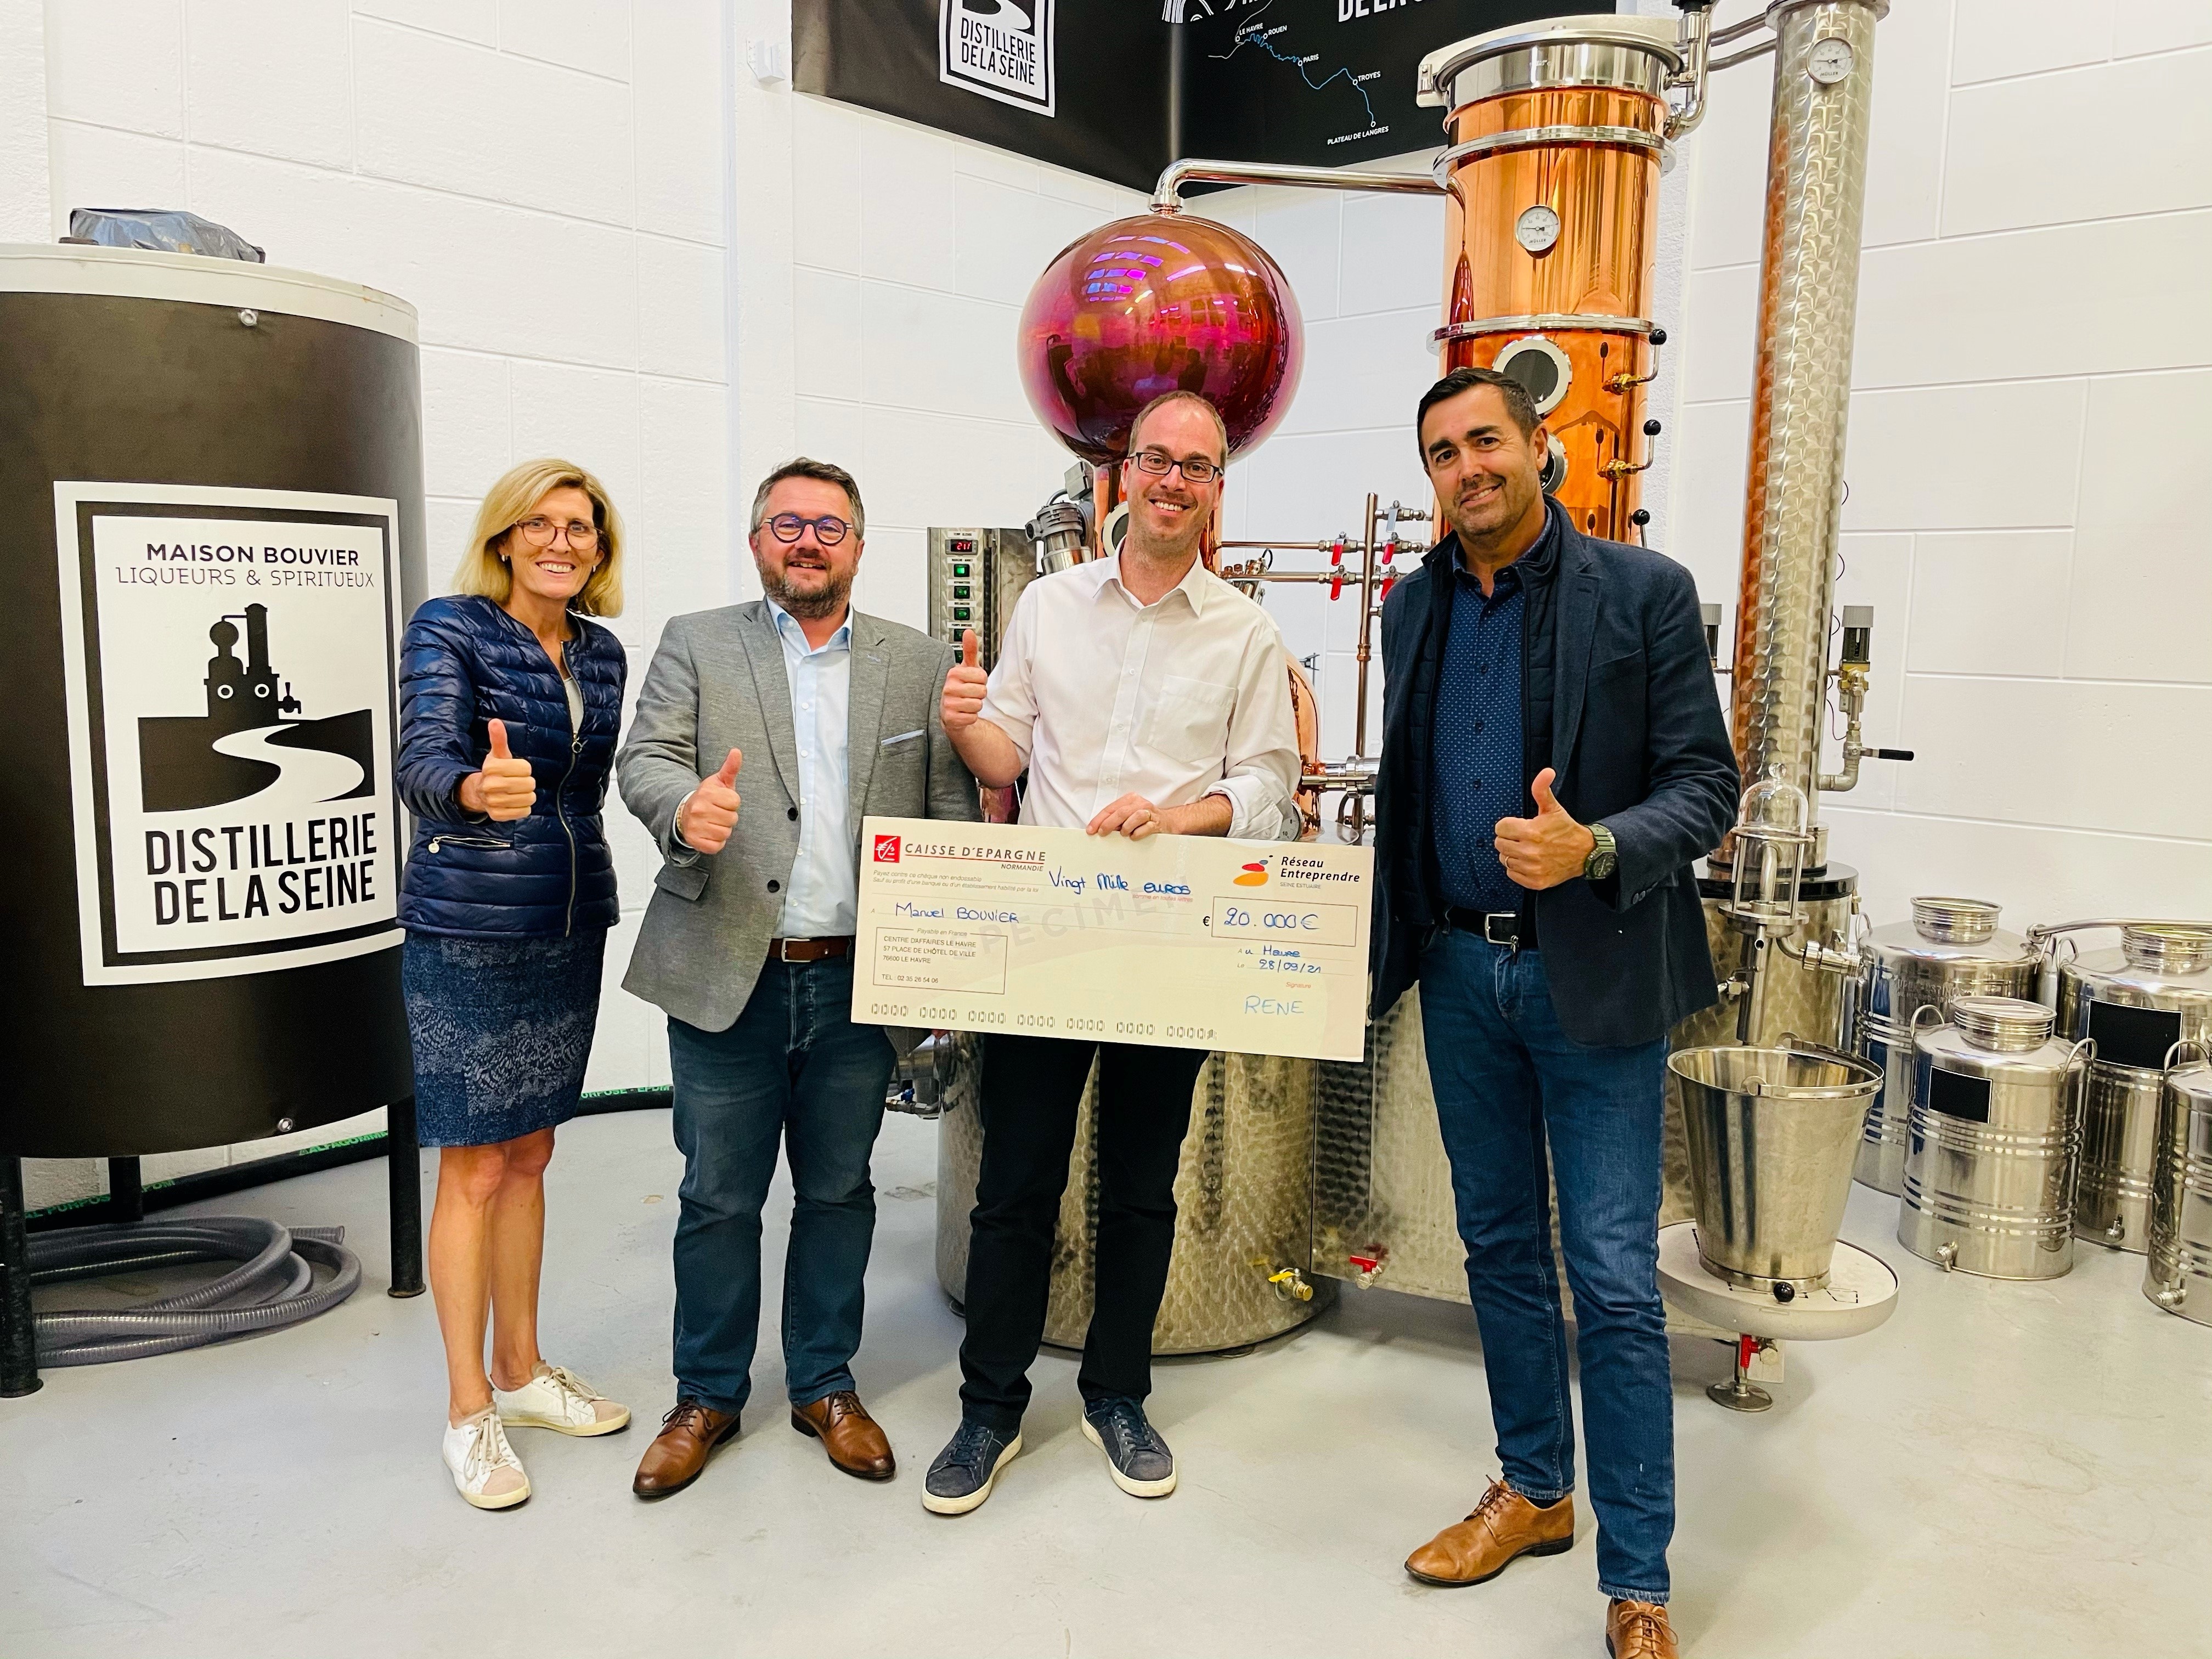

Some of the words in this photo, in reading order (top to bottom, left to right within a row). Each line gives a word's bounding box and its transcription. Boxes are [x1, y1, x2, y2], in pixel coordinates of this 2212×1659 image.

[1246, 23, 1263, 33] HAVRE
[1268, 25, 1287, 35] ROUEN
[961, 18, 1036, 63] DISTILLERIE
[962, 42, 978, 66] DE
[980, 48, 995, 72] LA
[999, 55, 1035, 85] SEINE
[1303, 54, 1319, 63] PARIS
[1358, 71, 1381, 82] TROYES
[1328, 133, 1352, 145] PLATEAU
[1362, 126, 1389, 137] LANGRES
[147, 544, 254, 562] MAISON
[264, 548, 359, 566] BOUVIER
[116, 567, 236, 586] LIQUEURS
[246, 569, 261, 585] &
[272, 570, 375, 587] SPIRITUEUX
[145, 812, 377, 875] DISTILLERIE
[905, 843, 956, 856] CAISSE
[1282, 856, 1324, 867] Réseau
[1049, 866, 1086, 894] Vingt
[1281, 868, 1359, 882] Entreprendre
[155, 878, 209, 926] DE
[218, 876, 269, 921] LA
[278, 859, 376, 915] SEINE
[896, 902, 944, 918] Manuel
[957, 906, 1019, 923] BOUVIER
[1203, 916, 1210, 927] €
[1245, 995, 1304, 1015] RENE
[581, 1088, 627, 1098] URPOSE
